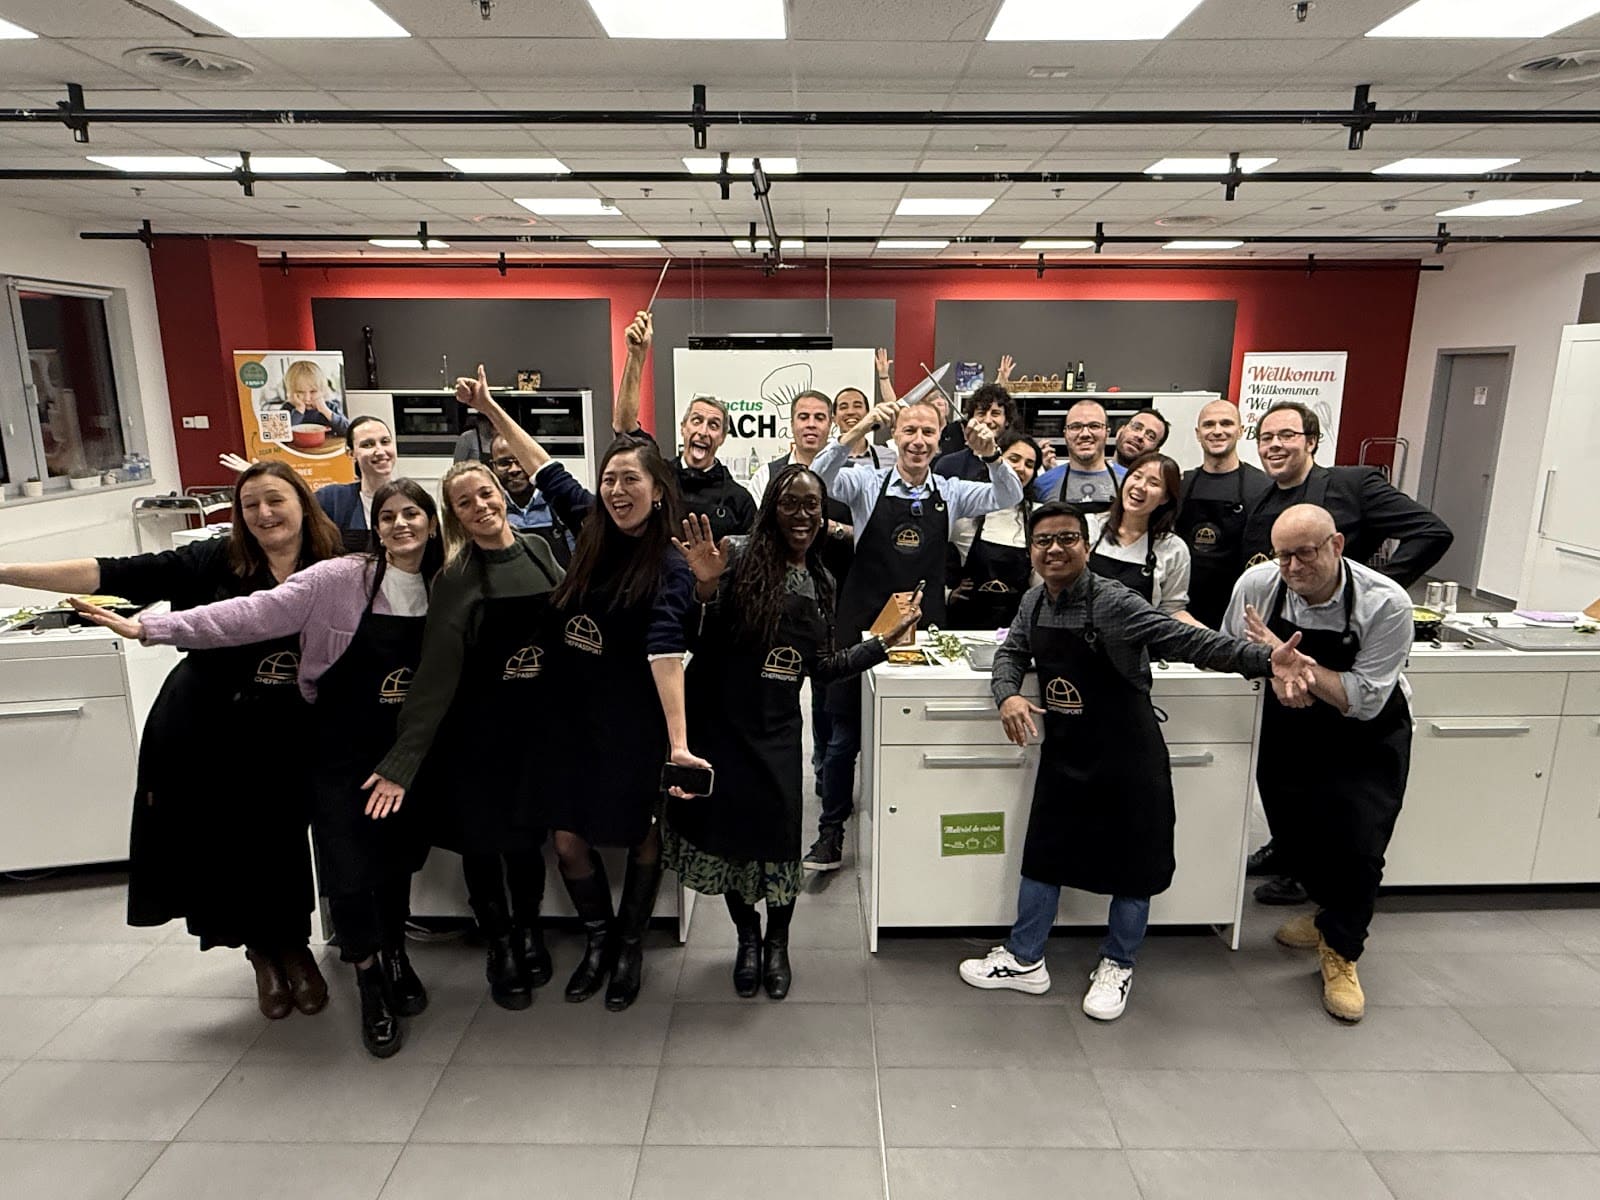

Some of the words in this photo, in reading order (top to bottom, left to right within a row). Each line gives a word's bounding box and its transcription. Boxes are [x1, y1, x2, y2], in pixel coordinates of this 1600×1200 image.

[1248, 383, 1319, 396] Willkommen
[725, 399, 763, 411] actus
[727, 414, 776, 439] ACH
[111, 641, 119, 651] 1
[1252, 681, 1261, 691] 3
